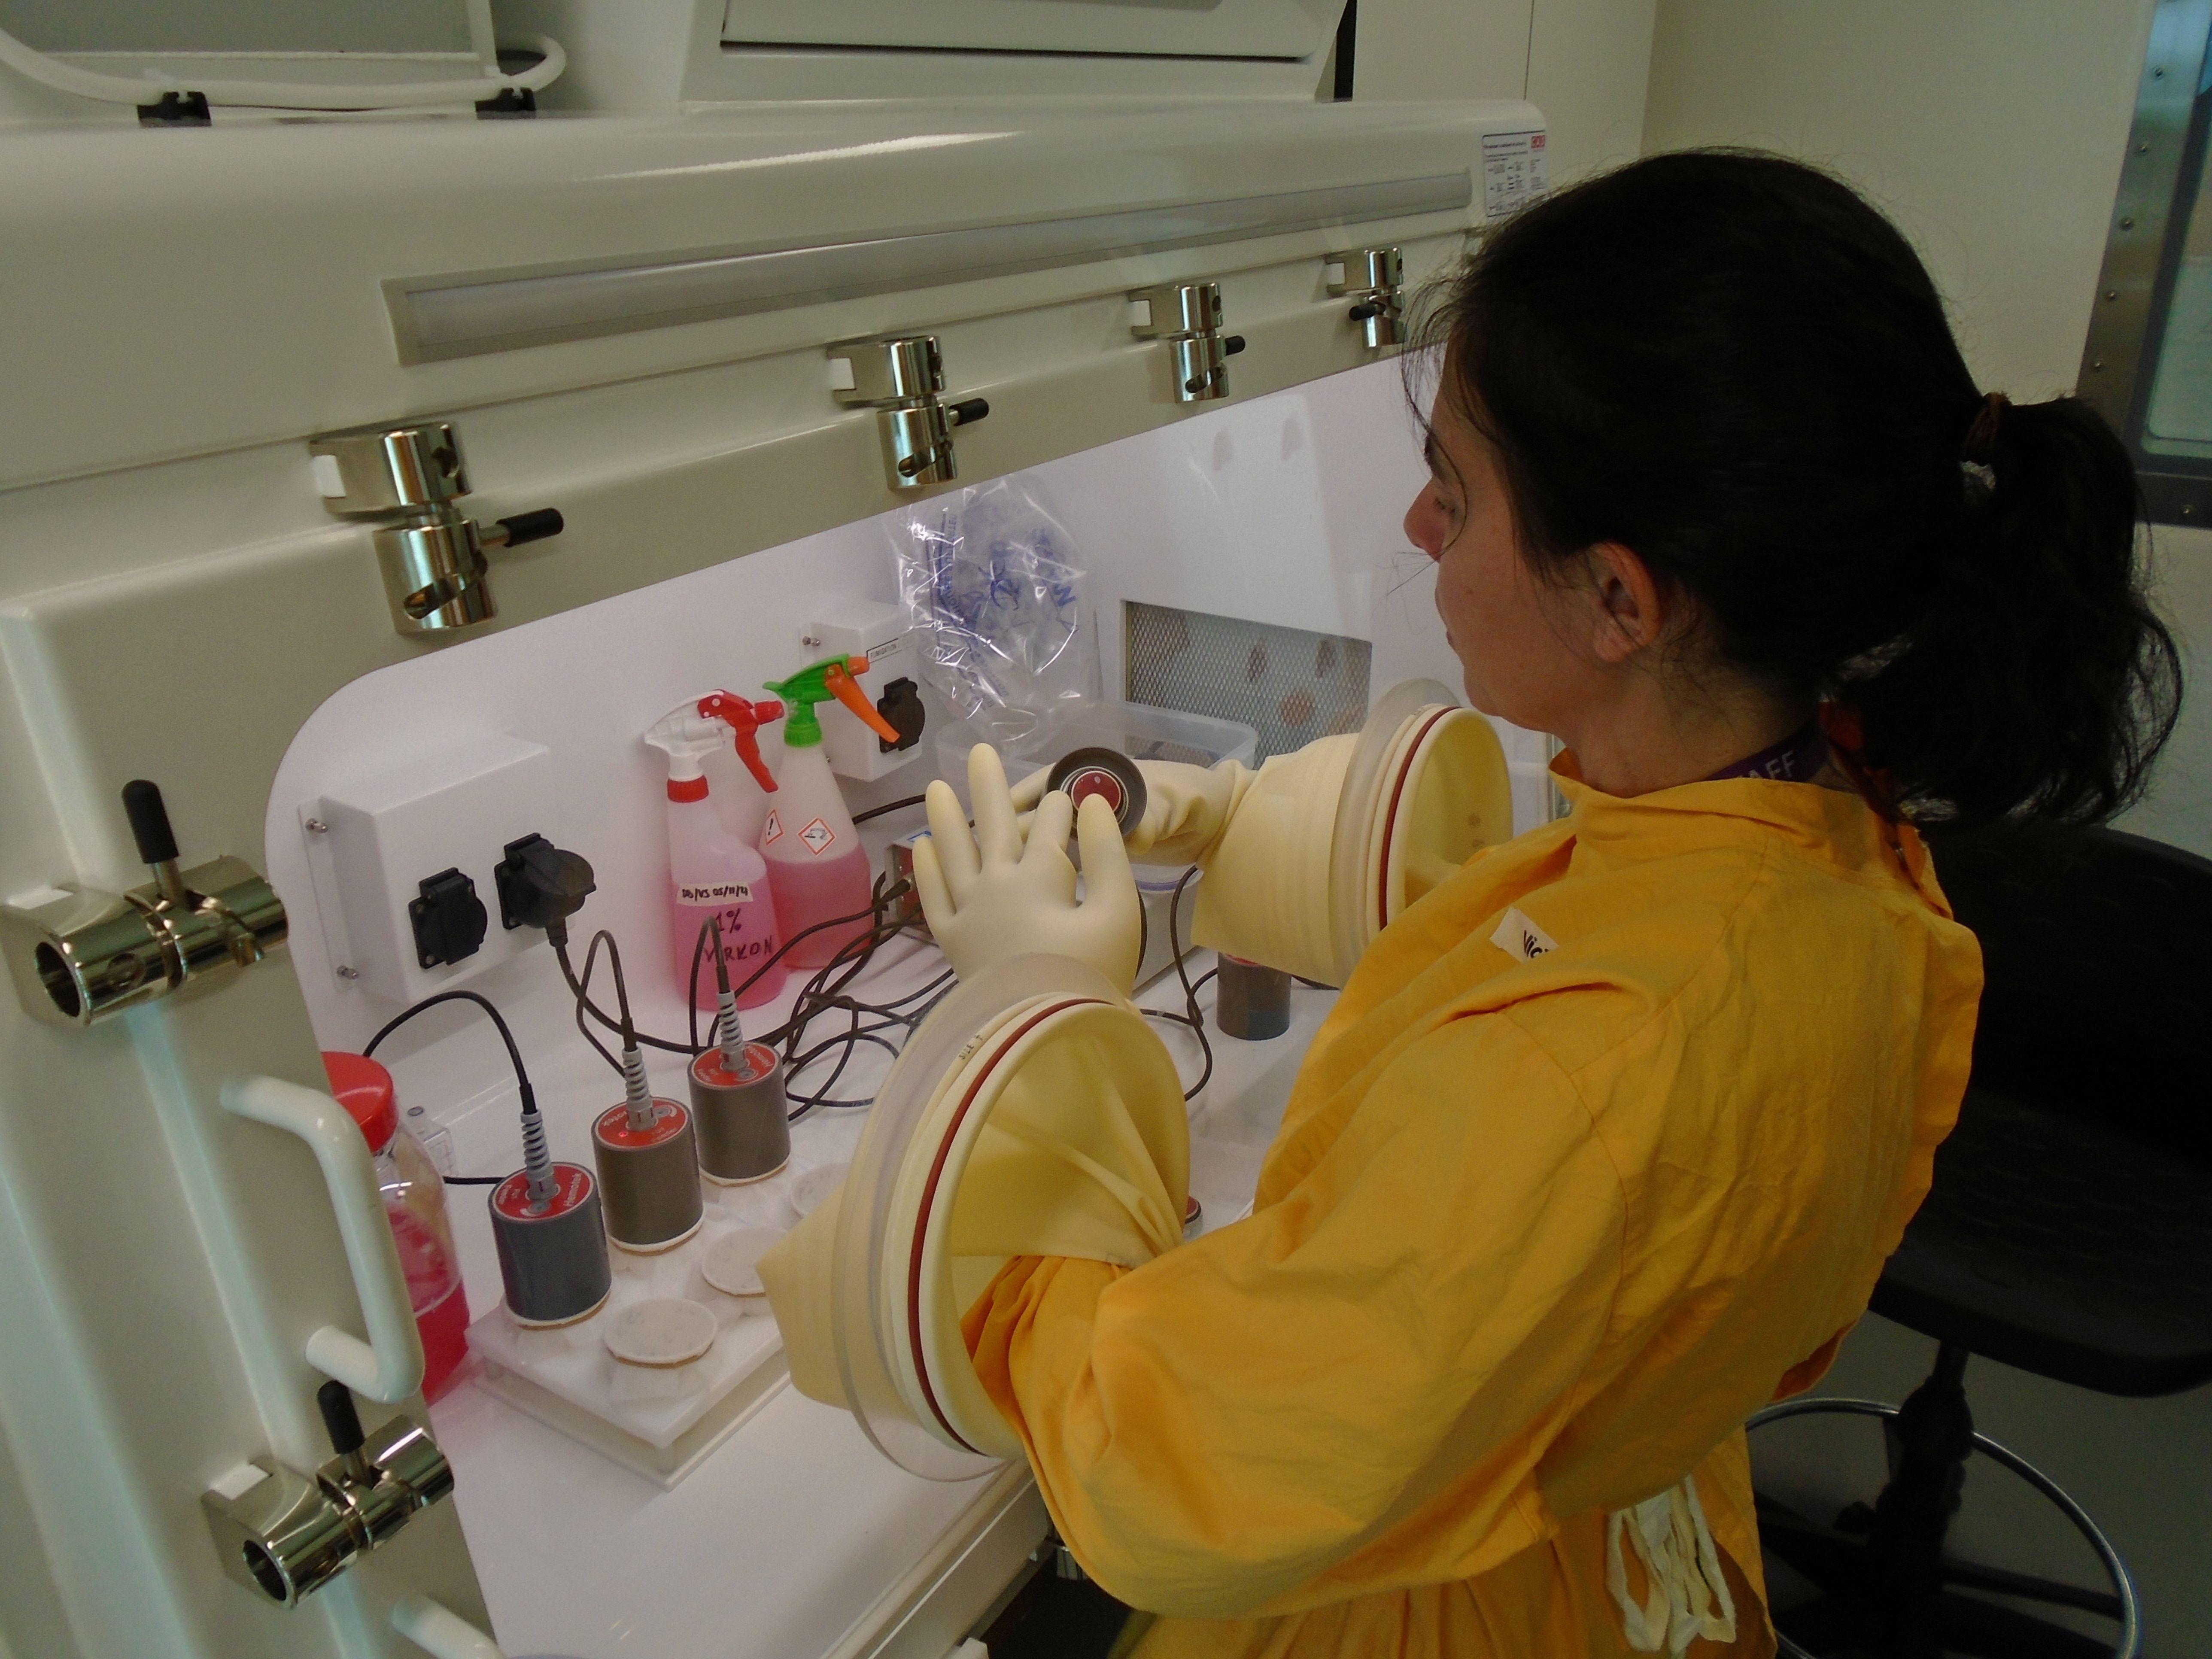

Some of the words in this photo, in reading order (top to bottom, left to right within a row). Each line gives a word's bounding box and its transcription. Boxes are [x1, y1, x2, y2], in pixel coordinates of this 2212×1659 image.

[716, 908, 741, 933] 1%
[704, 935, 773, 962] VRKON
[1523, 930, 1549, 958] Vic
